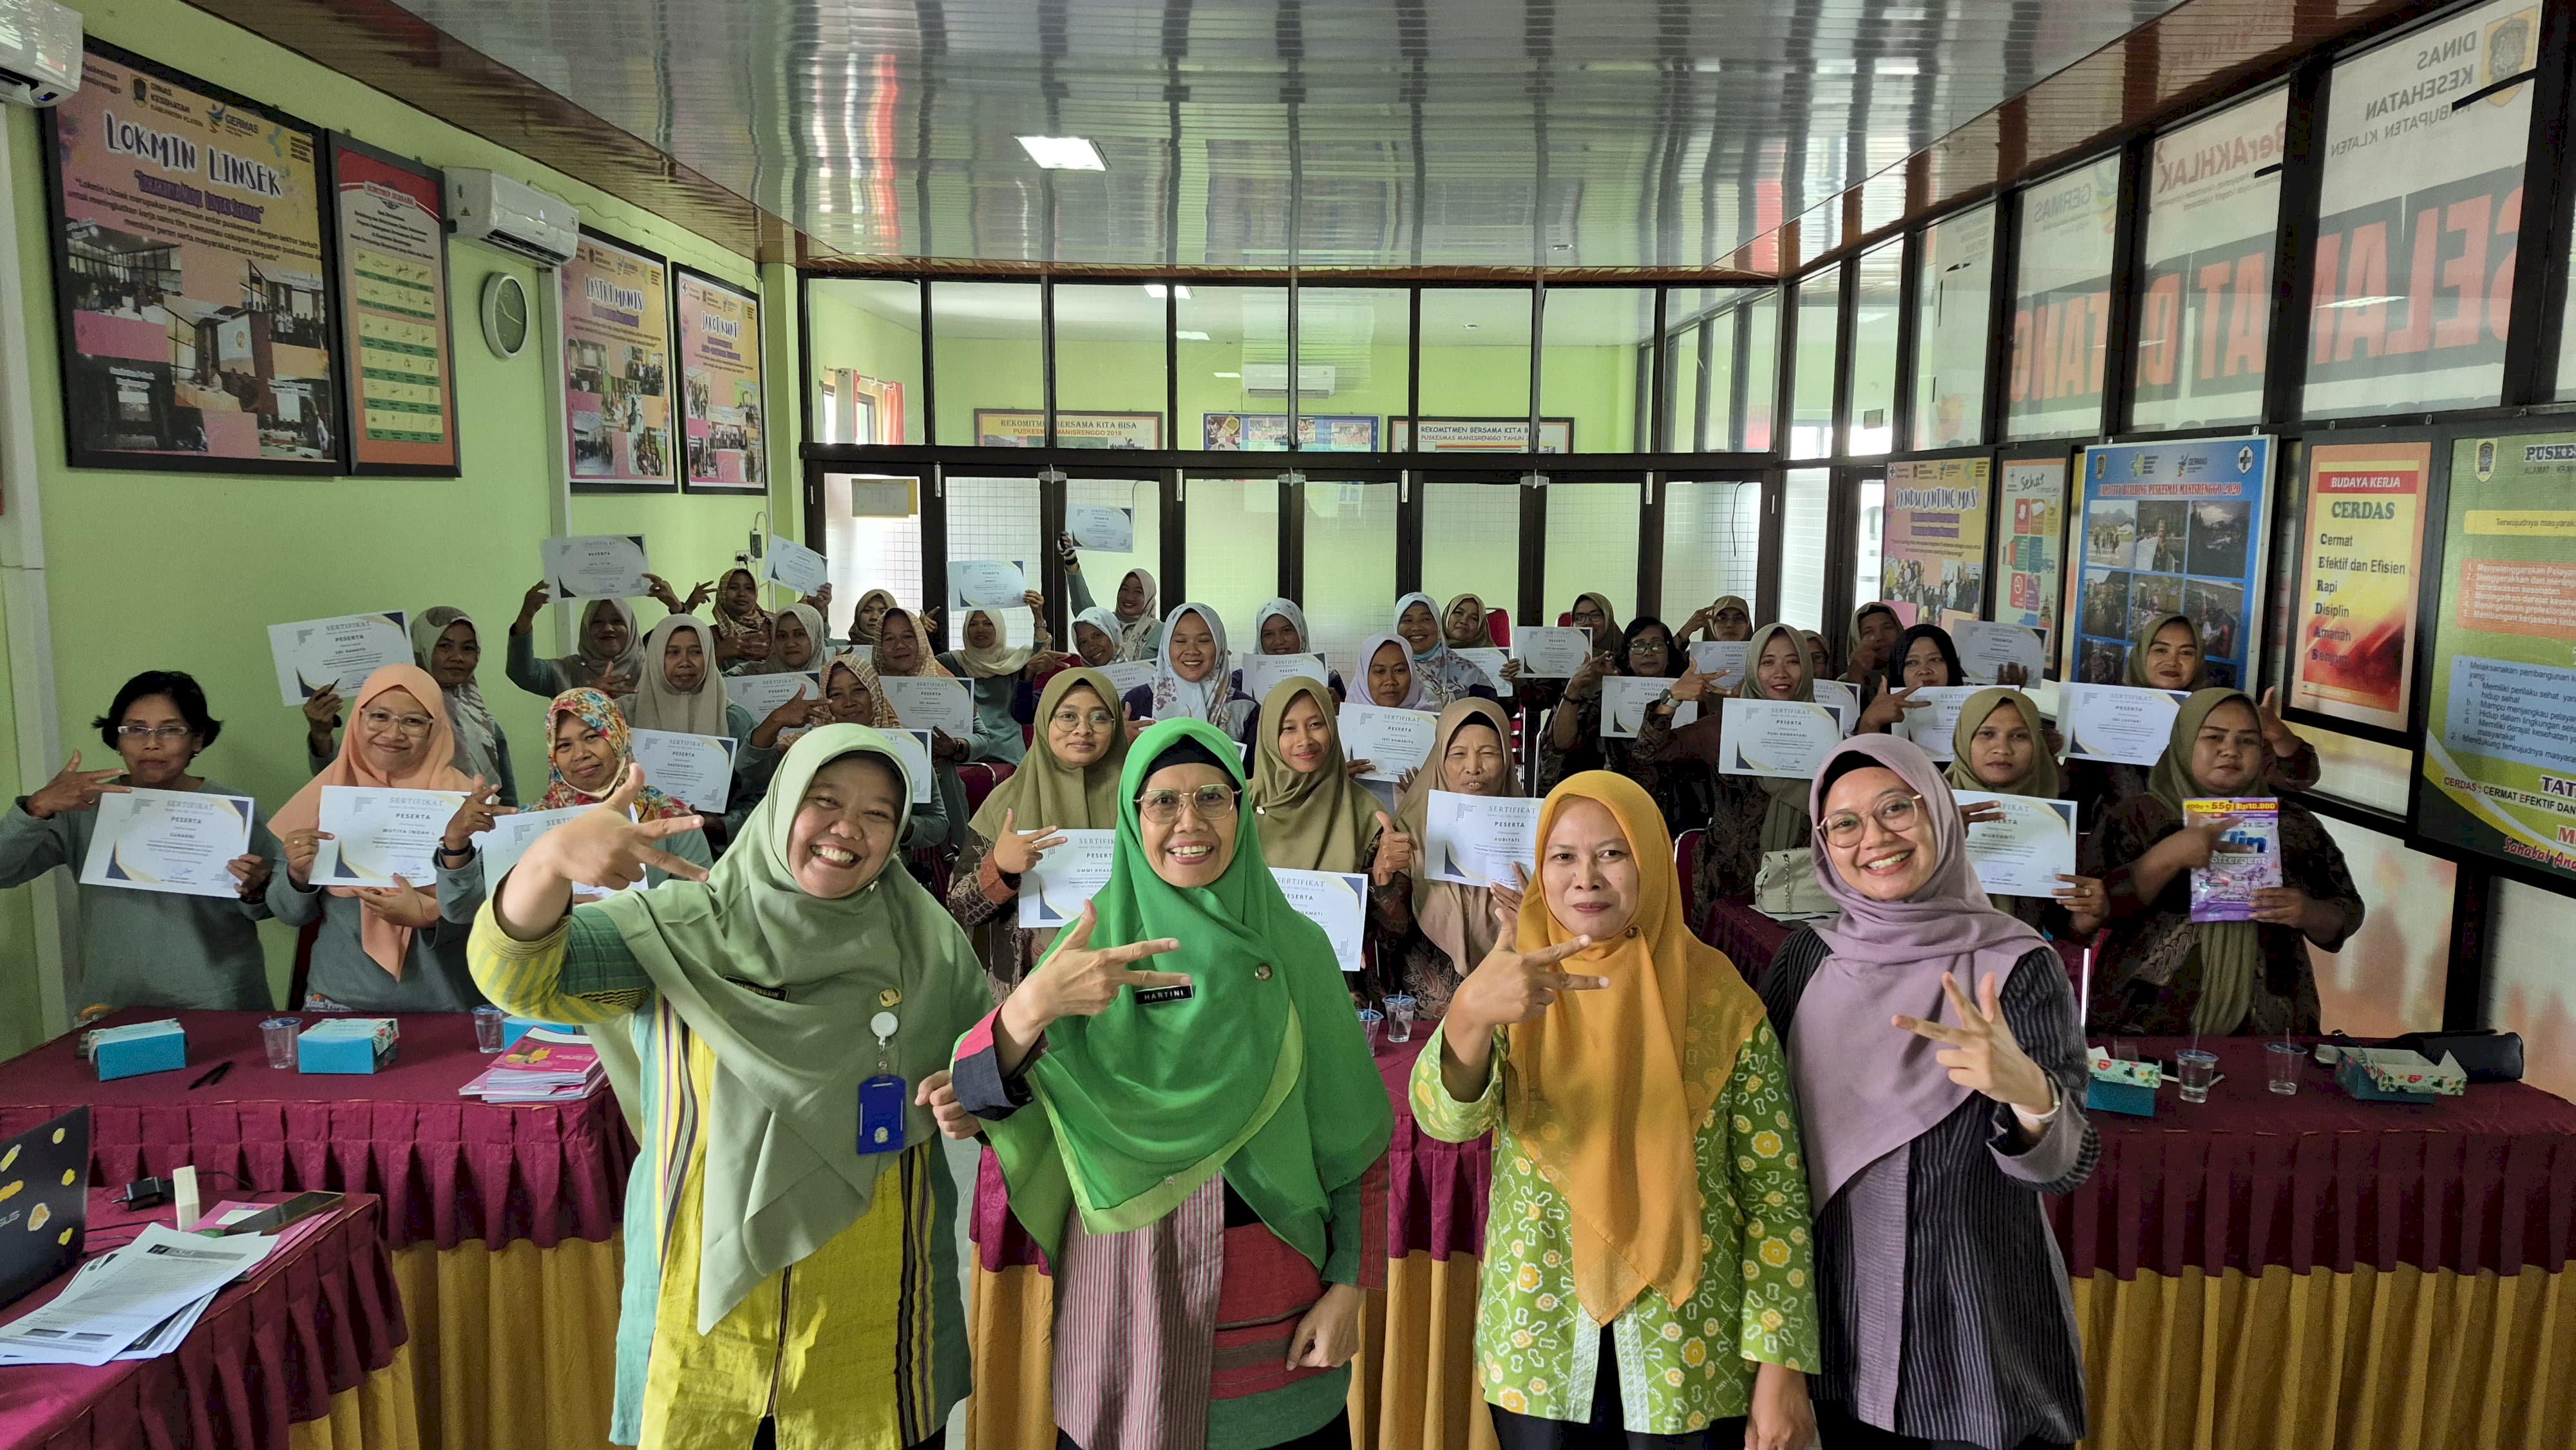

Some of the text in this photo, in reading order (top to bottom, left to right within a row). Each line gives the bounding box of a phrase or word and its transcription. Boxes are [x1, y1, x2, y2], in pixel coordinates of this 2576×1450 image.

[106, 112, 195, 169] LOKMIN
[209, 147, 281, 195] LINSEK
[2526, 444, 2576, 461] PUSKE
[2223, 483, 2240, 495] 2020
[2331, 476, 2401, 488] BUDAYA KERJA
[1958, 488, 1976, 509] MAS
[2332, 501, 2395, 520] CERDAS
[2496, 518, 2539, 528] Terwujudnya
[2320, 533, 2353, 547] Cermat
[2318, 556, 2405, 575] Efektif dan Efisien
[2316, 579, 2338, 595] Rapi
[2315, 603, 2349, 619] Disiplin
[326, 621, 370, 632] SERTIFIKAT
[2314, 628, 2351, 642] Amanah
[2470, 662, 2570, 681] Melaksanakan pembangunan
[2470, 672, 2485, 681] yang
[2110, 693, 2153, 702] SERTIFIKAT
[2481, 691, 2499, 701] hidup
[2483, 683, 2559, 700] Memiliki perilaku sehat
[2481, 701, 2505, 711] Mampu
[2507, 706, 2548, 718] menjangkau
[1384, 714, 1420, 722] SERTIFIKAT
[2480, 710, 2560, 730] Hidup dalam lingkungan
[2477, 729, 2515, 742] masyarakat
[2479, 719, 2568, 742] Memiliki derajat kesehatan
[2463, 735, 2501, 750] Mendukung
[2503, 742, 2543, 757] terwujudnya
[2444, 777, 2477, 792] CERDAS
[2483, 786, 2518, 801] CERMAT
[2519, 793, 2555, 809] EFEKTIF
[166, 800, 214, 809] SERTIFIKAT
[390, 797, 444, 807] SERTIFIKAT
[2211, 802, 2231, 811] 55g
[1489, 805, 1536, 814] SERTIFIKAT
[2558, 827, 2576, 845] M
[2504, 837, 2550, 863] Sahabat
[2211, 856, 2268, 866] oftergent
[1277, 877, 1325, 887] SERTIFIKAT
